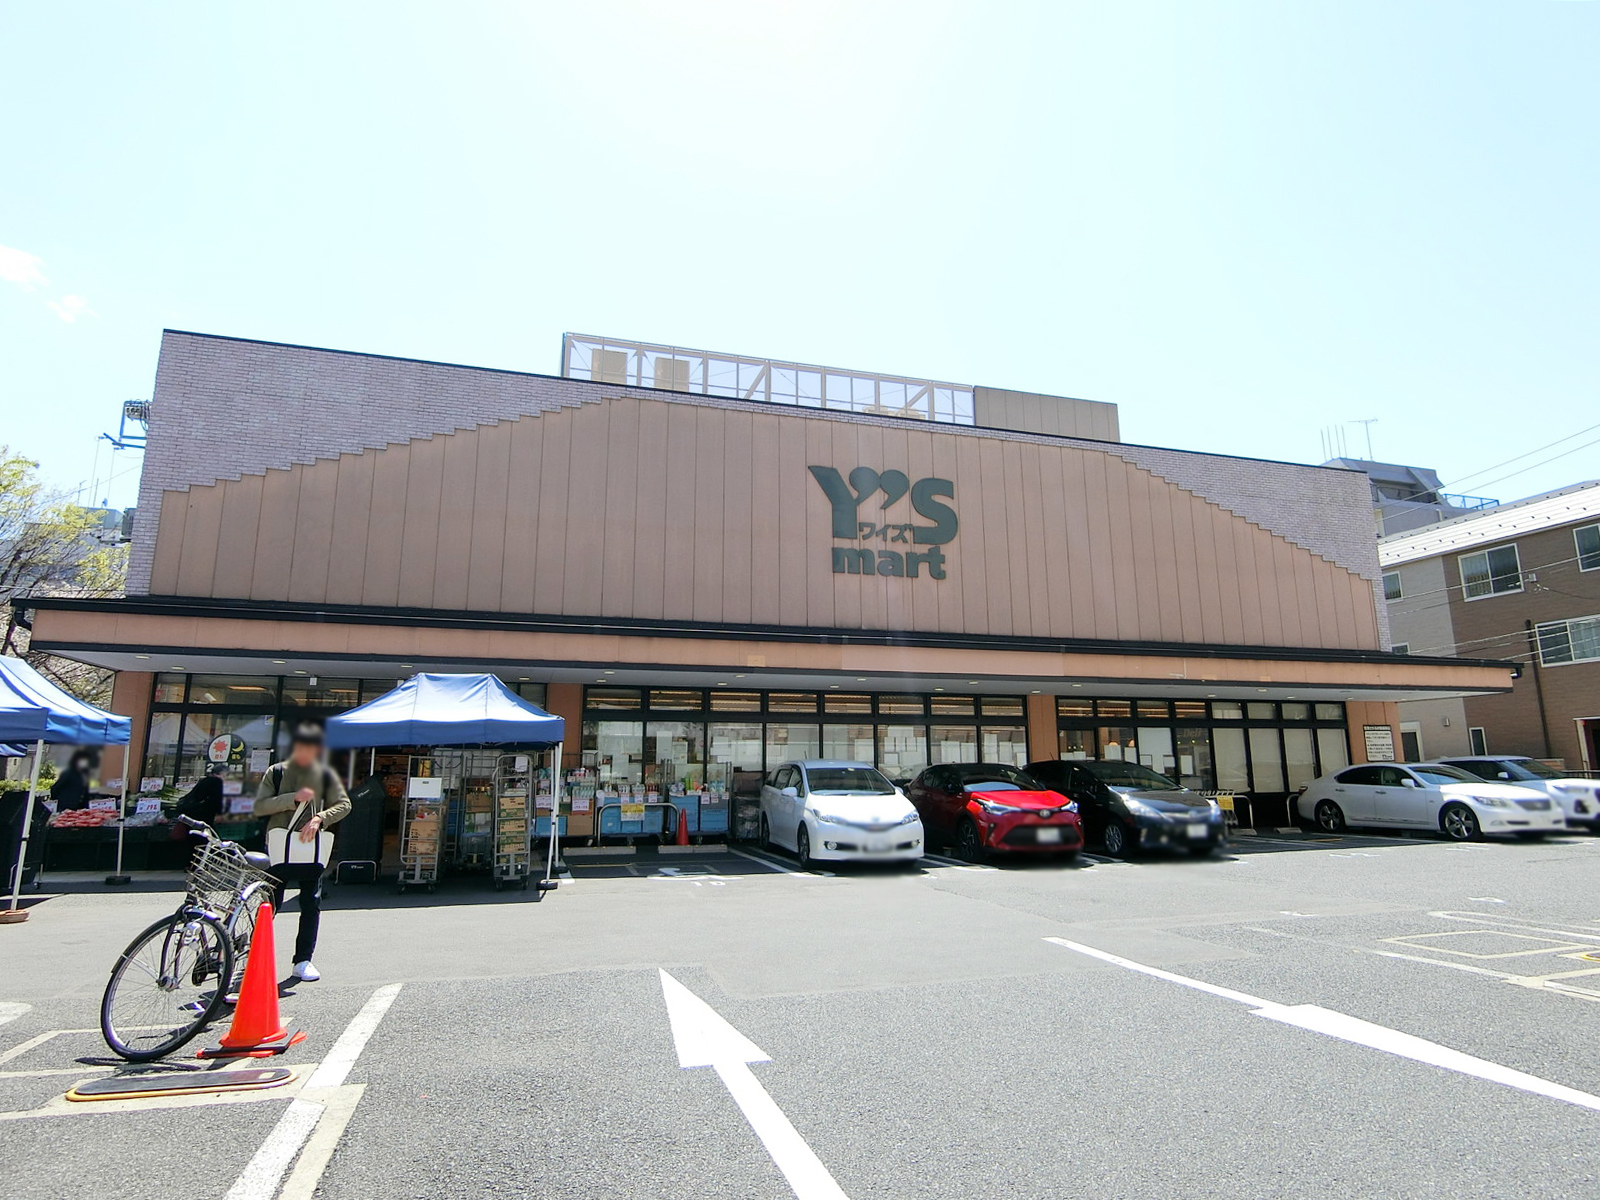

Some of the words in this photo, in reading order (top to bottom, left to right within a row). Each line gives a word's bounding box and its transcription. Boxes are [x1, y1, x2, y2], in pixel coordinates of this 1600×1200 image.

[859, 522, 913, 543] ワイズ
[831, 546, 946, 580] mart
